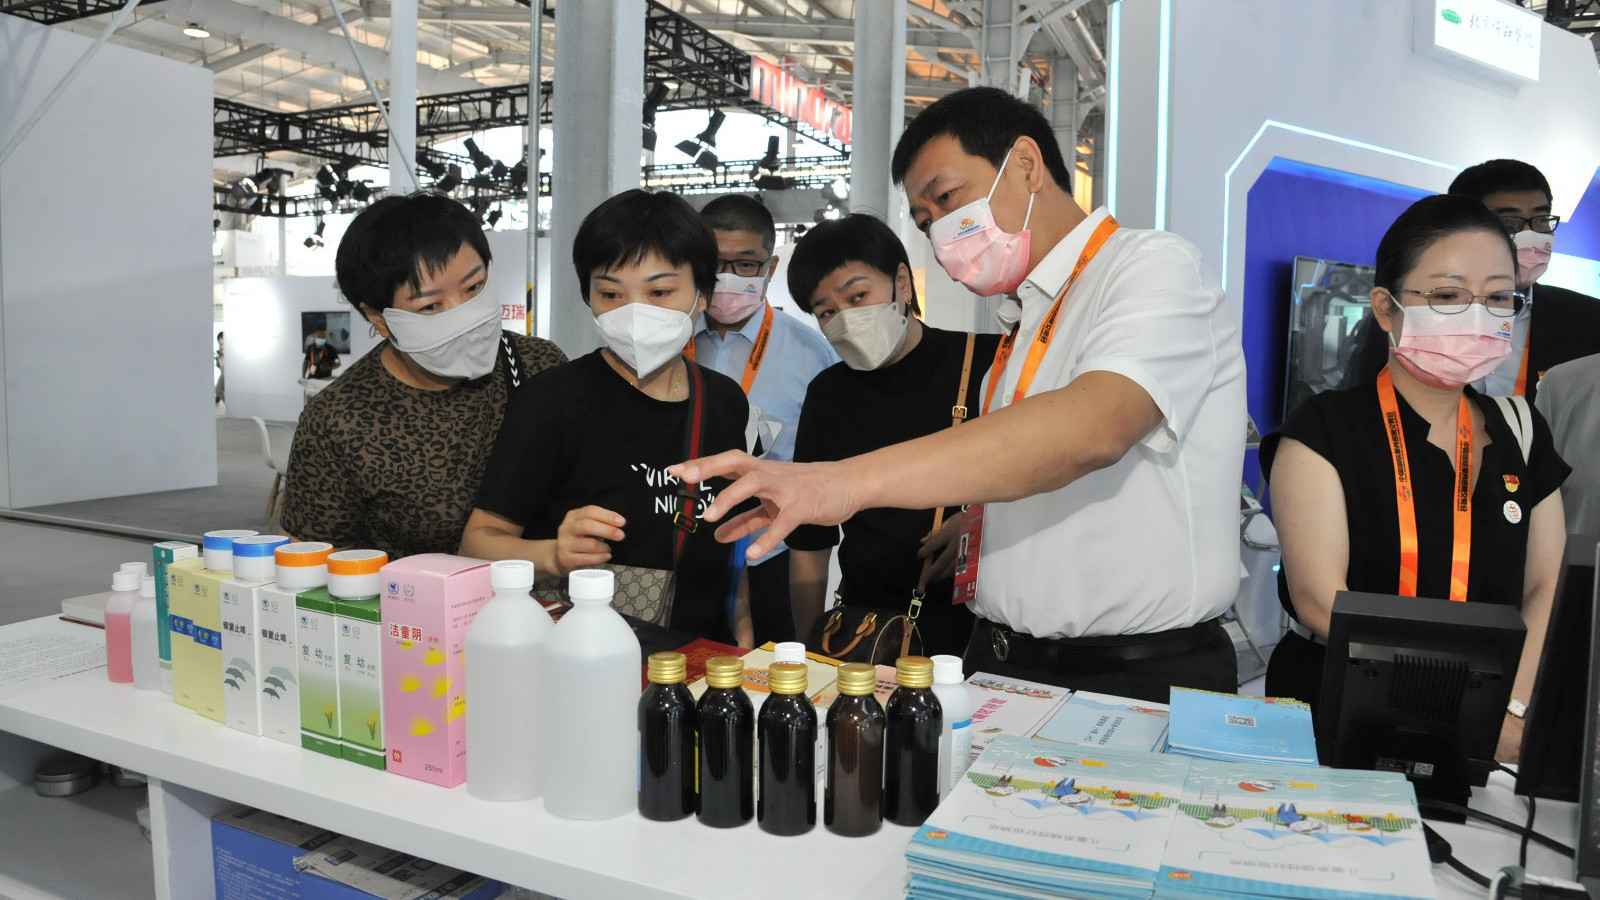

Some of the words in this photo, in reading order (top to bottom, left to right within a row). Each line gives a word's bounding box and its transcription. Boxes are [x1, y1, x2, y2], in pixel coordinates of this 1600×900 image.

[500, 303, 525, 320] 迈瑞
[389, 624, 422, 642] 洁童阴
[424, 763, 443, 774] 250ml
